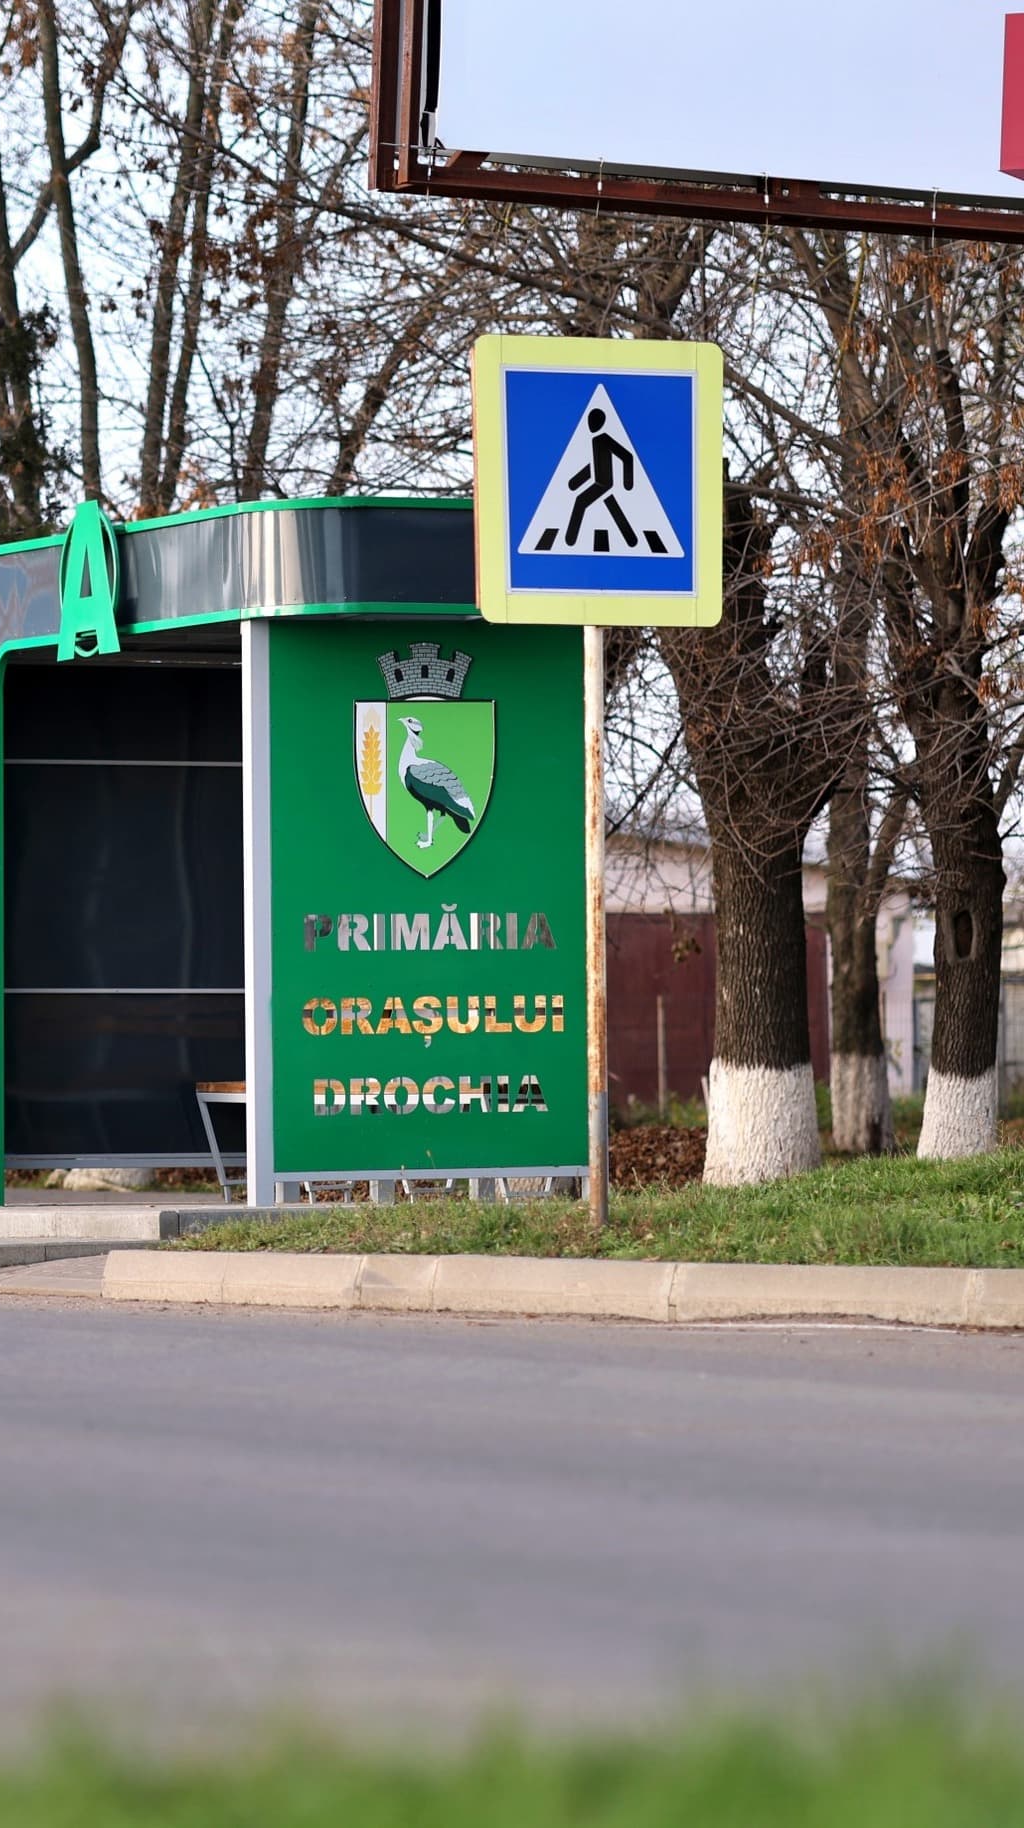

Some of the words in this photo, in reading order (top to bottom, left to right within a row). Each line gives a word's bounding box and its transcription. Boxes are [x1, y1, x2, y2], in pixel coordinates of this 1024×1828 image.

[57, 500, 120, 662] A
[304, 903, 557, 951] PRIMĂRIA
[302, 995, 564, 1048] ORAȘULUI
[314, 1075, 549, 1116] DROCHIA
